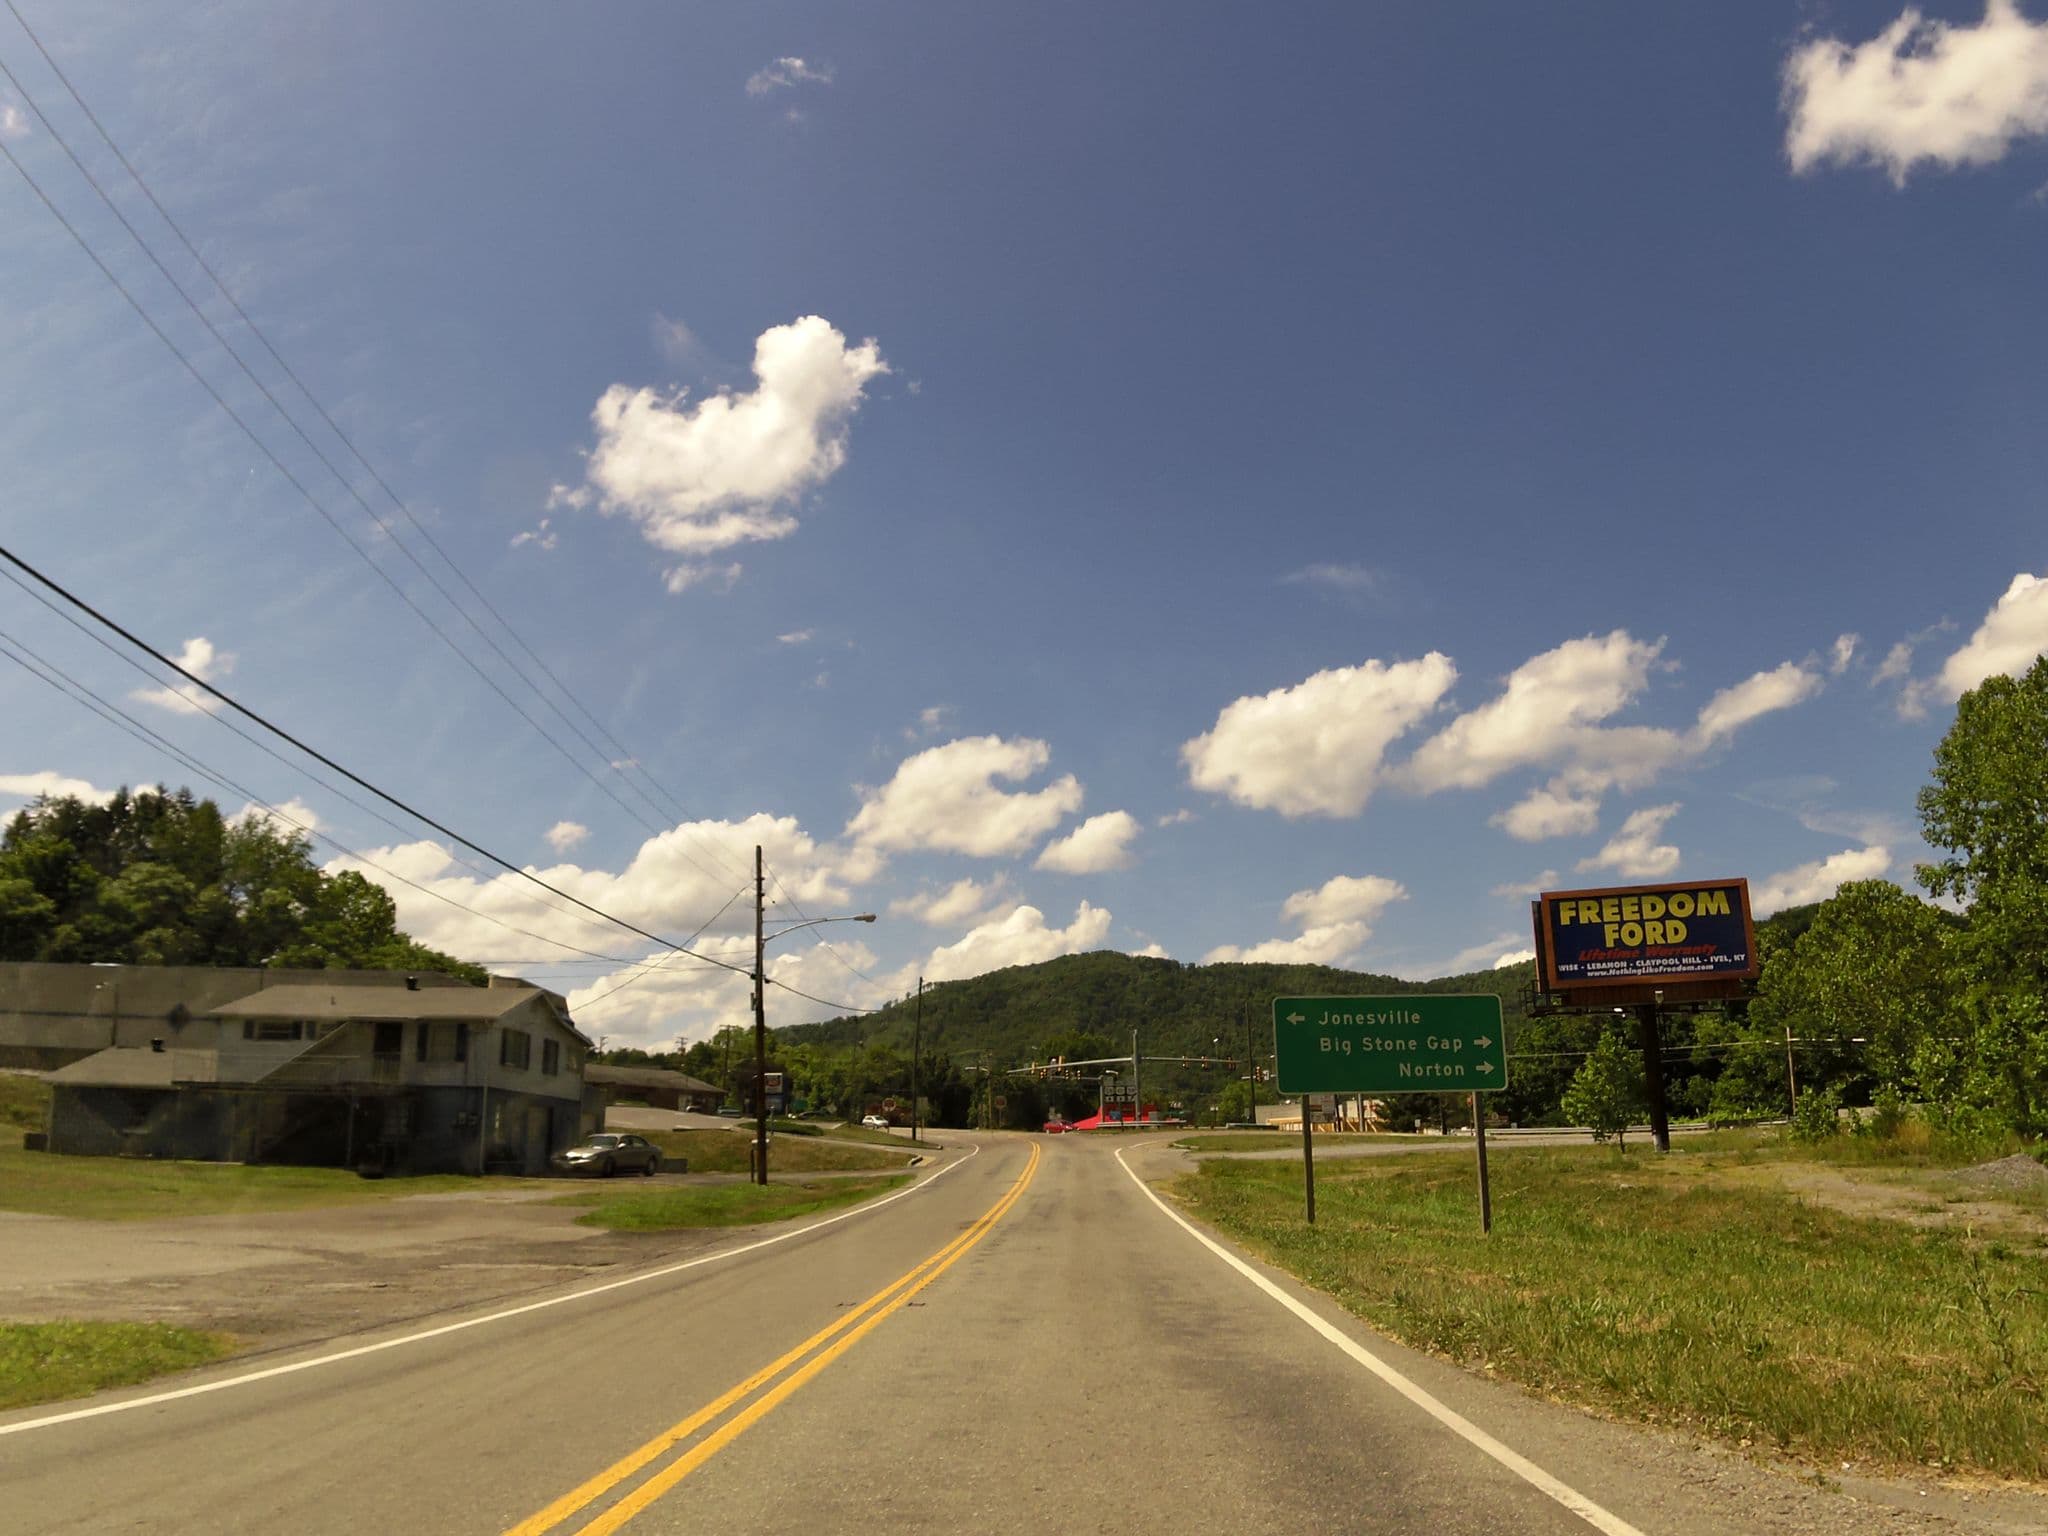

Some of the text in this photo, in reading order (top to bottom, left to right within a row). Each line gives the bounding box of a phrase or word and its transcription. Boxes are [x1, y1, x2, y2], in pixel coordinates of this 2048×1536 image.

[1560, 890, 1731, 926] FREEDOM
[1604, 919, 1688, 948] FORD
[1579, 943, 1718, 961] Lifetime Warranty
[1558, 964, 1579, 972] WISE
[1587, 960, 1627, 970] LEBANON
[1635, 957, 1680, 967] CLAYPOOL
[1682, 955, 1701, 964] HILL
[1733, 953, 1746, 962] KY
[1318, 1010, 1421, 1026] Jonesville
[1319, 1035, 1463, 1056] Big Stone Gap
[1399, 1062, 1466, 1078] Norton
